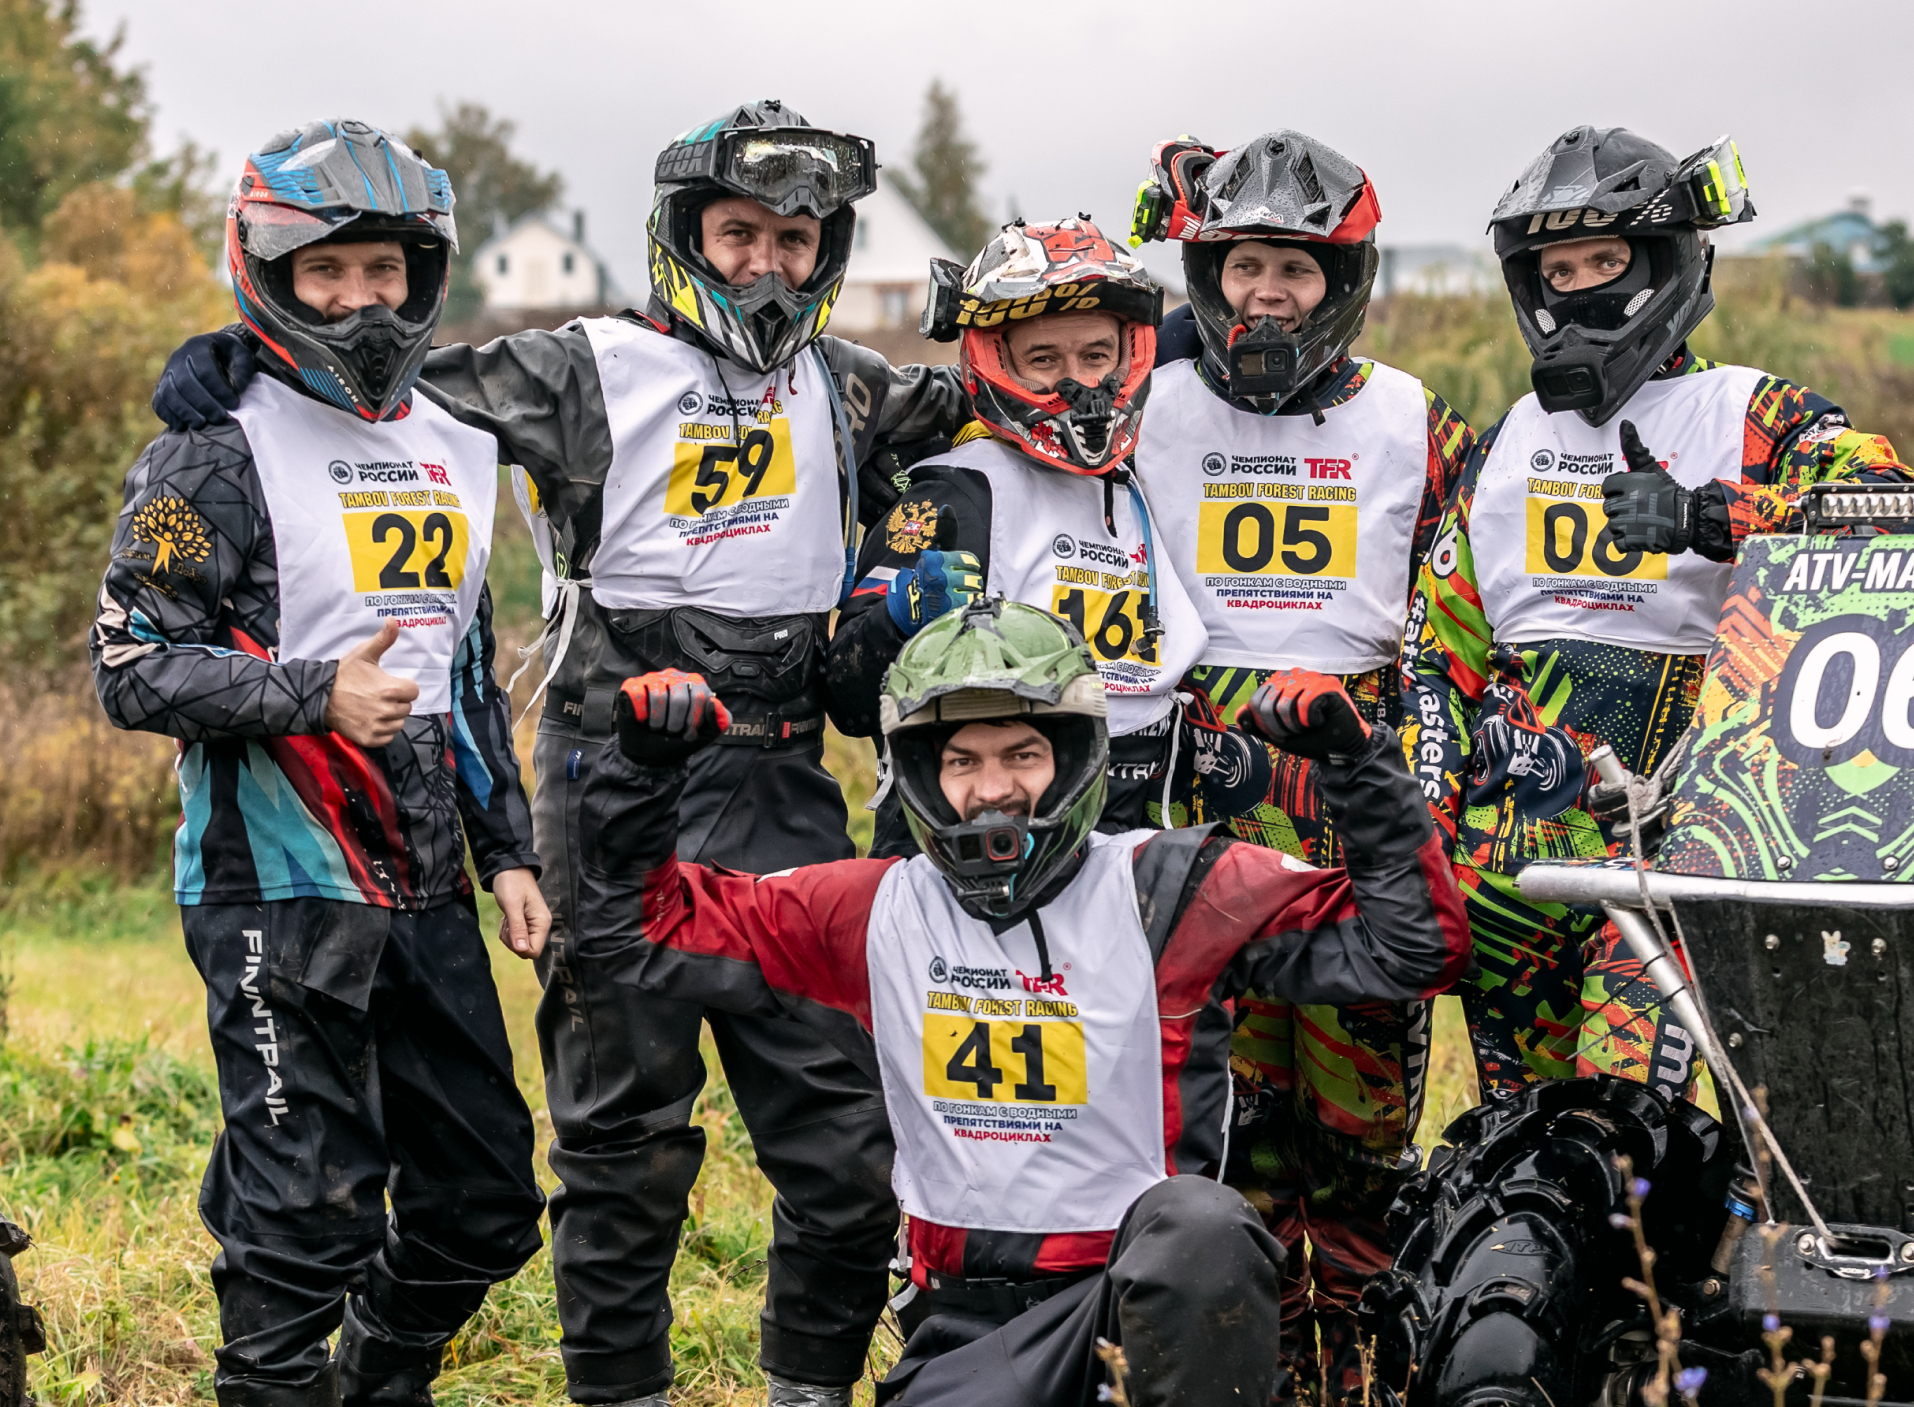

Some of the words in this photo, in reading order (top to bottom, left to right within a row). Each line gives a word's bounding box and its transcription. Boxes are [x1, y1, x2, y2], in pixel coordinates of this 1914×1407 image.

[956, 282, 1101, 327] 100%
[327, 365, 359, 403] AIROH
[679, 423, 730, 439] TAMBOV
[354, 461, 413, 471] ЧЕМПИОНАТ
[1231, 455, 1296, 464] ЧЕМПИОНАТ
[1560, 453, 1614, 463] ЧЕМПИОНАТ
[358, 470, 419, 482] РОССИИ
[691, 429, 774, 515] 59
[1231, 464, 1296, 476] РОССИИ
[1558, 461, 1613, 475] РОССИИ
[1203, 483, 1254, 498] TAMBOV
[1257, 483, 1305, 500] FOREST
[1308, 486, 1356, 501] RACING
[1528, 478, 1577, 497] TAMBOV
[338, 491, 389, 508] TAMBOV
[389, 491, 431, 506] FOREST
[669, 518, 688, 529] ПО
[763, 512, 779, 523] НА
[686, 524, 771, 546] КВАДРОЦИКЛАХ
[1222, 502, 1332, 574] 05
[371, 513, 453, 589] 22
[1079, 540, 1125, 557] ЧЕМПИОНАТ
[1080, 549, 1129, 569] РОССИИ
[1055, 565, 1099, 586] TAMBOV
[1101, 570, 1136, 590] FOREST
[1206, 577, 1223, 587] ПО
[1225, 578, 1273, 587] ГОНКАМ
[1275, 578, 1284, 588] С
[1285, 579, 1346, 590] ВОДНЫМИ
[1533, 578, 1545, 587] ПО
[1546, 578, 1585, 588] ГОНКАМ
[1586, 580, 1595, 588] С
[1595, 581, 1657, 593] ВОДНЫМИ
[365, 596, 382, 606] ПО
[1216, 589, 1314, 599] ПРЕПЯТСТВИЯМИ
[1317, 592, 1333, 600] НА
[1627, 595, 1644, 603] НА
[1227, 600, 1322, 610] КВАДРОЦИКЛАХ
[1554, 596, 1635, 612] КВАДРОЦИКЛАХ
[774, 629, 788, 640] PRO
[1104, 682, 1150, 693] РОЦИКЛАХ
[951, 975, 1012, 990] РОССИИ
[927, 991, 971, 1012] TAMBOV
[974, 998, 1022, 1016] FOREST
[1026, 1000, 1078, 1017] RACING
[242, 930, 289, 1126] FINNTRAIL
[946, 1022, 1056, 1101] 41
[933, 1101, 948, 1112] ПО
[950, 1103, 997, 1117] ГОНКАМ
[999, 1107, 1009, 1118] С
[1009, 1107, 1078, 1120] ВОДНЫМИ
[944, 1115, 1042, 1130] ПРЕПЯТСТВИЯМИ
[1045, 1121, 1063, 1131] НА
[954, 1128, 1052, 1143] КВАДРОЦИКЛАХ
